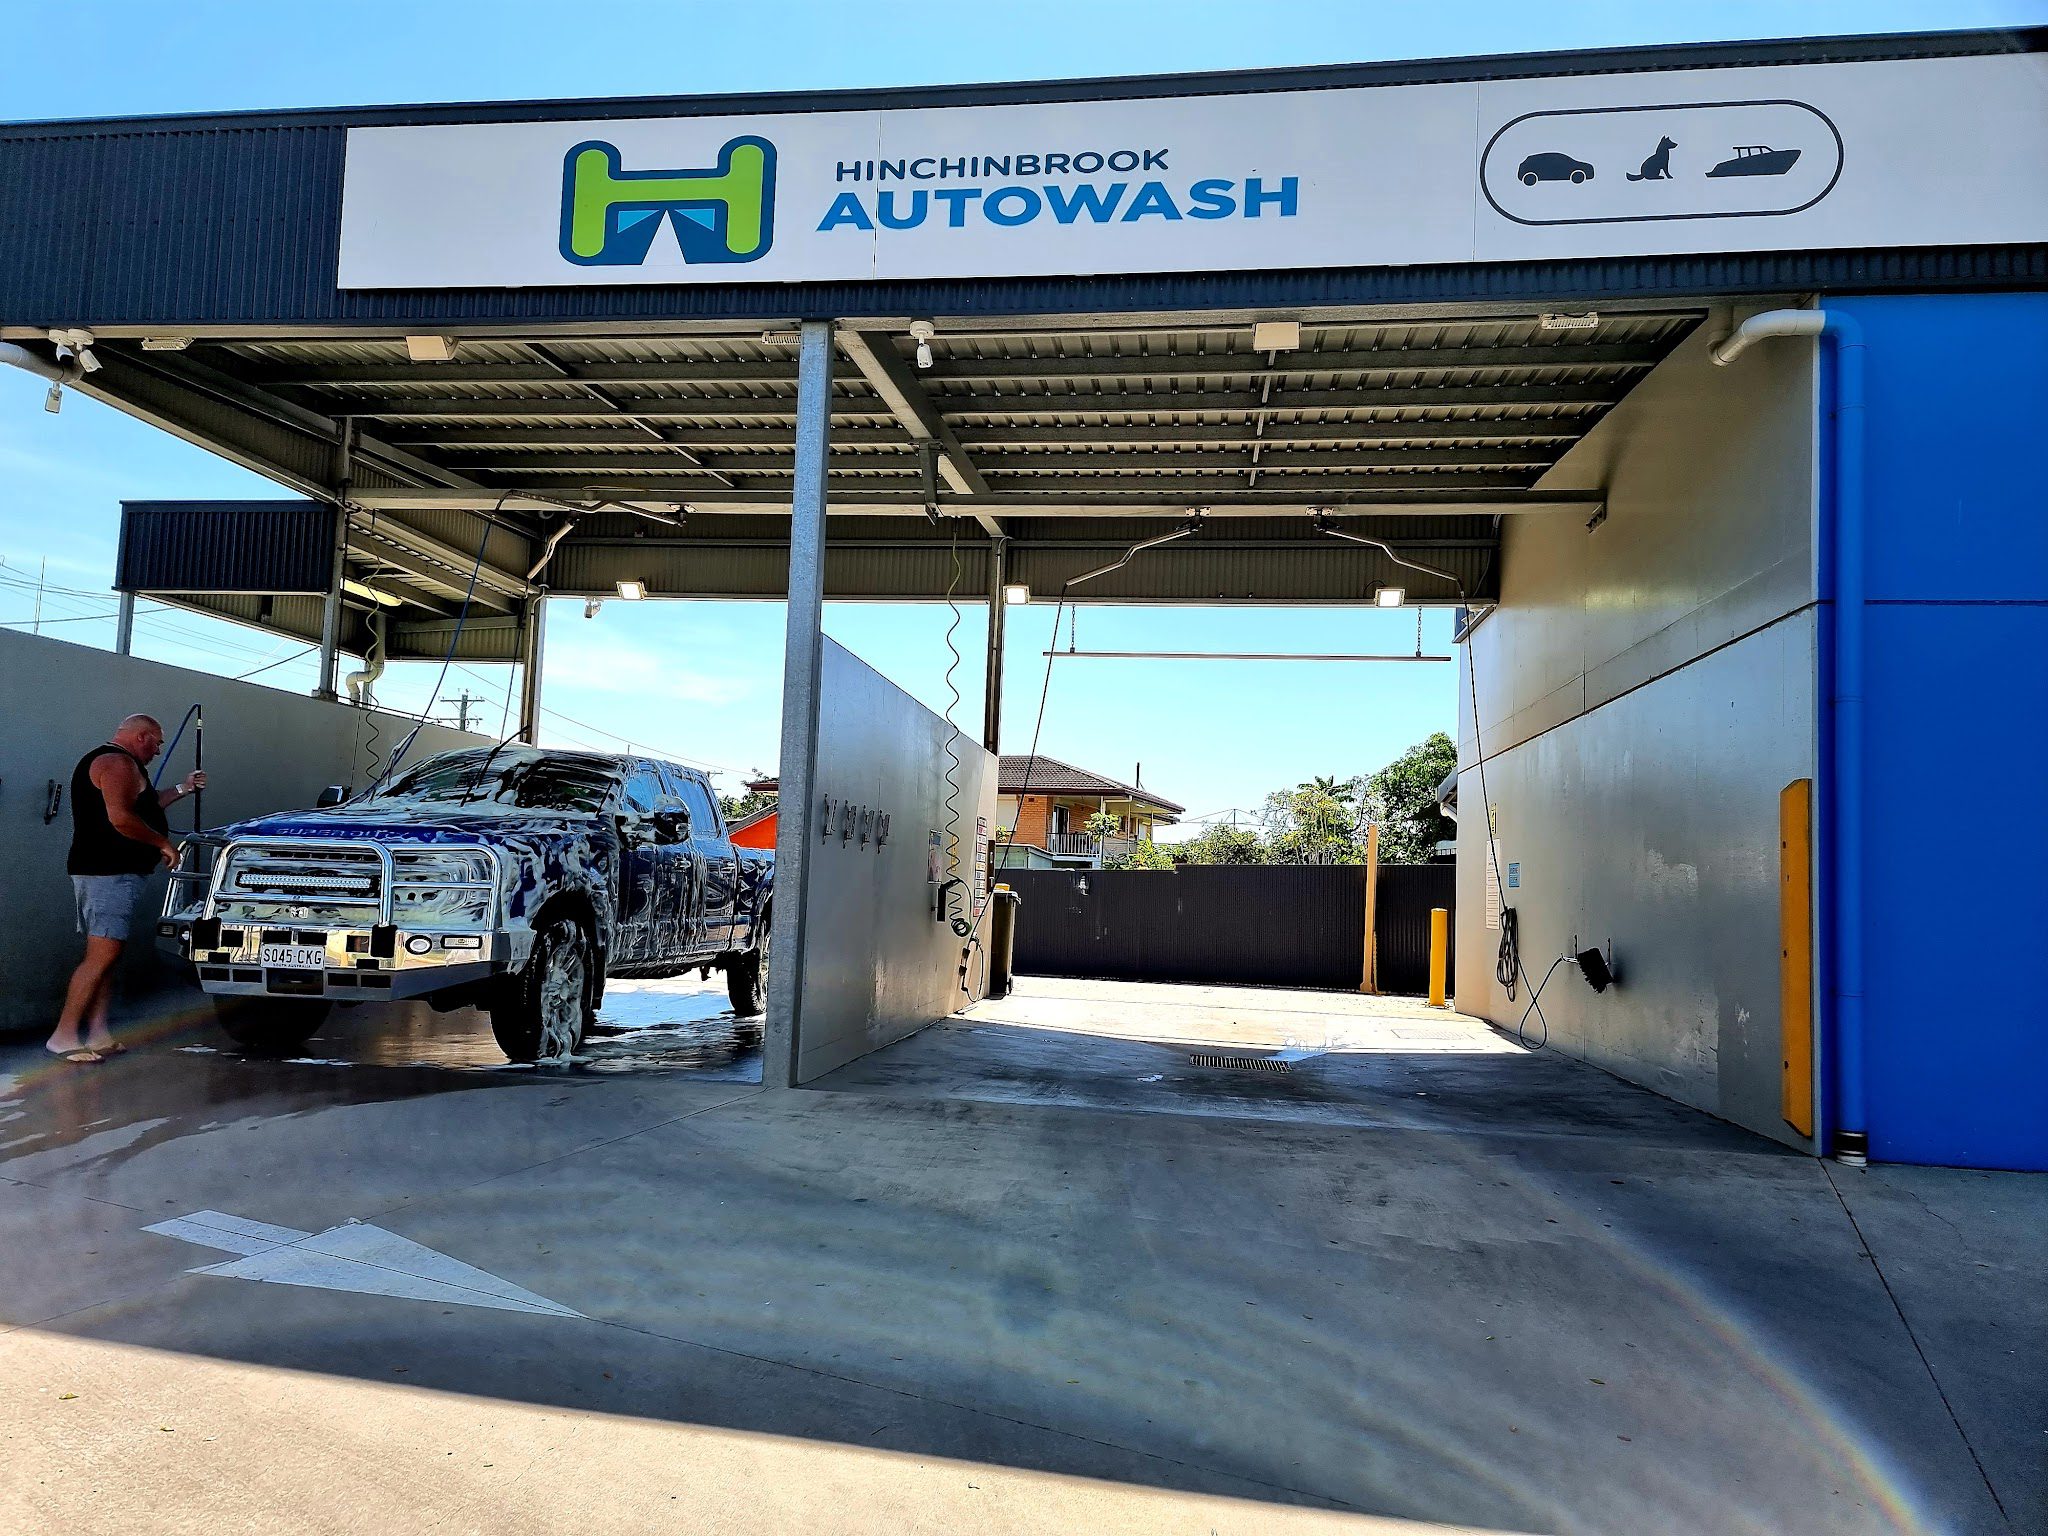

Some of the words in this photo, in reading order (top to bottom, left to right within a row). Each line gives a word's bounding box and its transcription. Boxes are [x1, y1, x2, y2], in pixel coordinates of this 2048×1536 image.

[835, 148, 1169, 182] HINCHINBROOK
[816, 176, 1299, 232] AUTOWASH
[263, 948, 322, 964] S045-CKG
